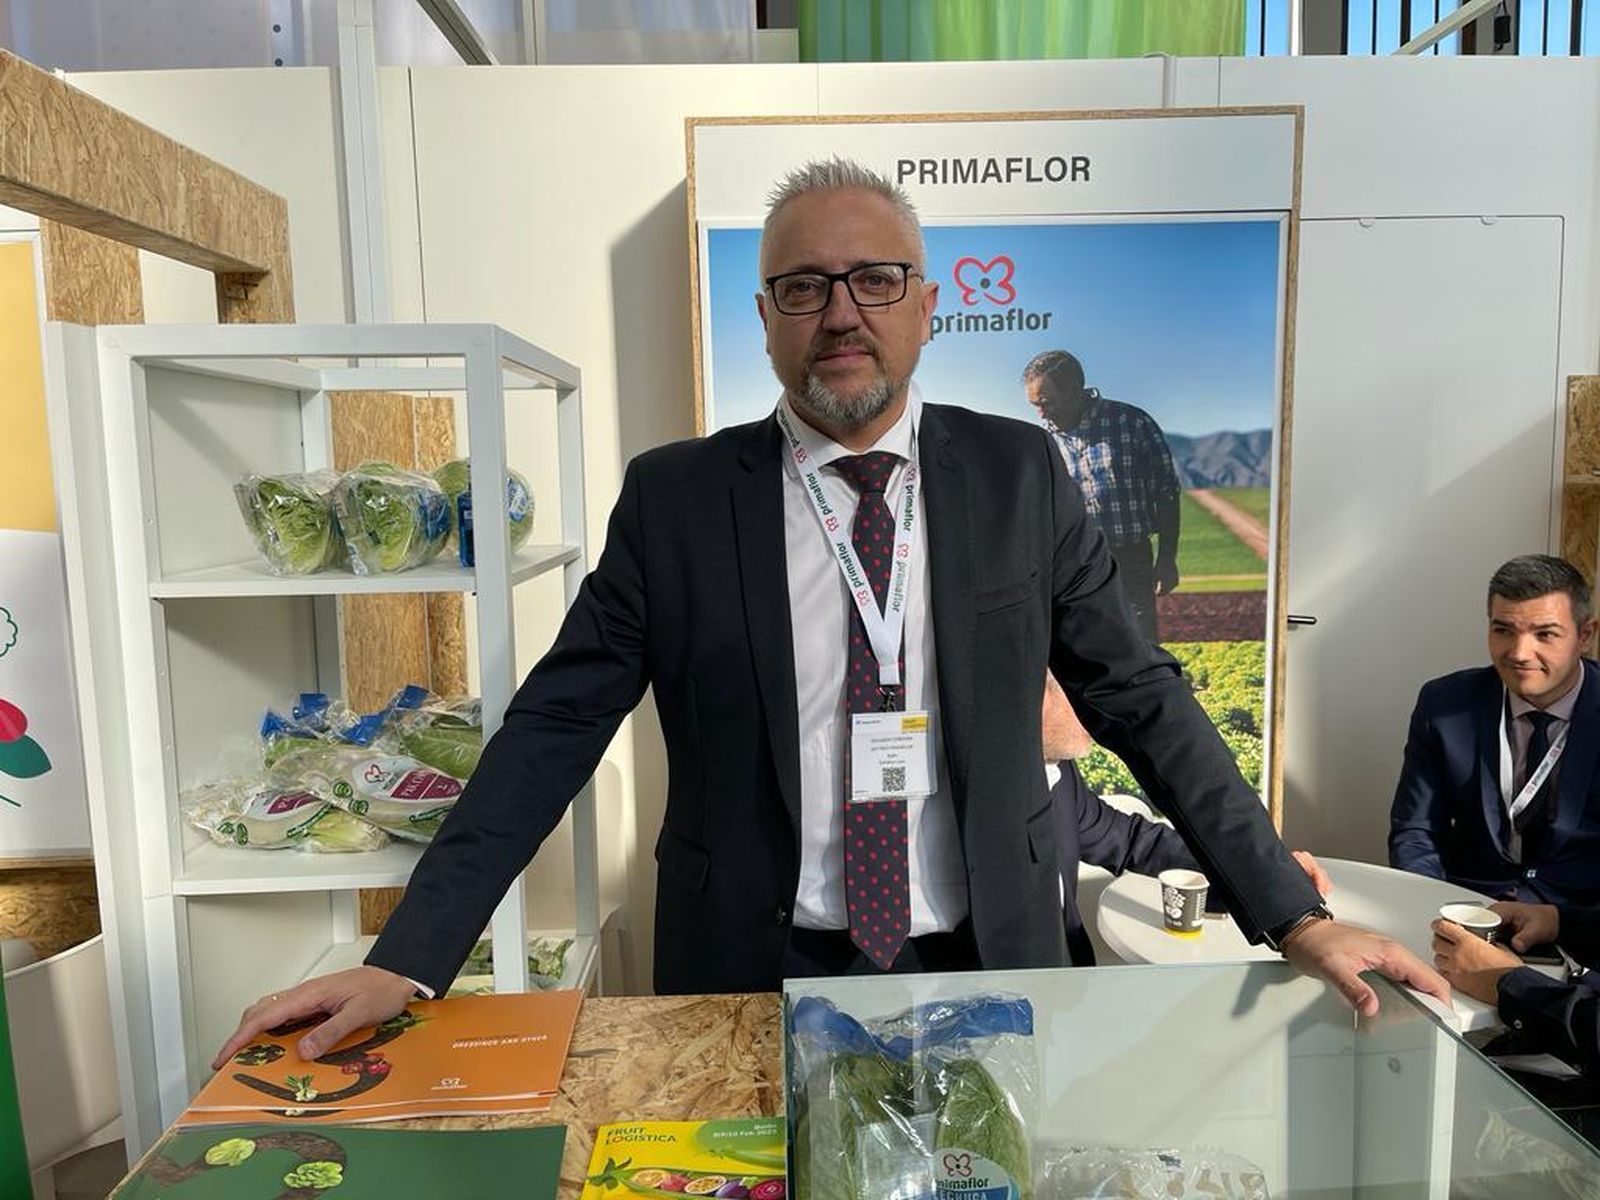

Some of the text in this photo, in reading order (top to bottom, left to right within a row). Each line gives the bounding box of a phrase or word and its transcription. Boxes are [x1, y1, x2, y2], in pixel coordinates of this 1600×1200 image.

[897, 156, 1091, 184] PRIMAFLOR
[930, 308, 1052, 340] primaflor
[806, 472, 833, 515] primaflor
[903, 484, 914, 532] primaflor
[836, 541, 864, 588] primaflor
[891, 560, 908, 613] primaflor
[605, 1135, 676, 1145] LOGISTICA
[607, 1127, 645, 1137] FRUIT
